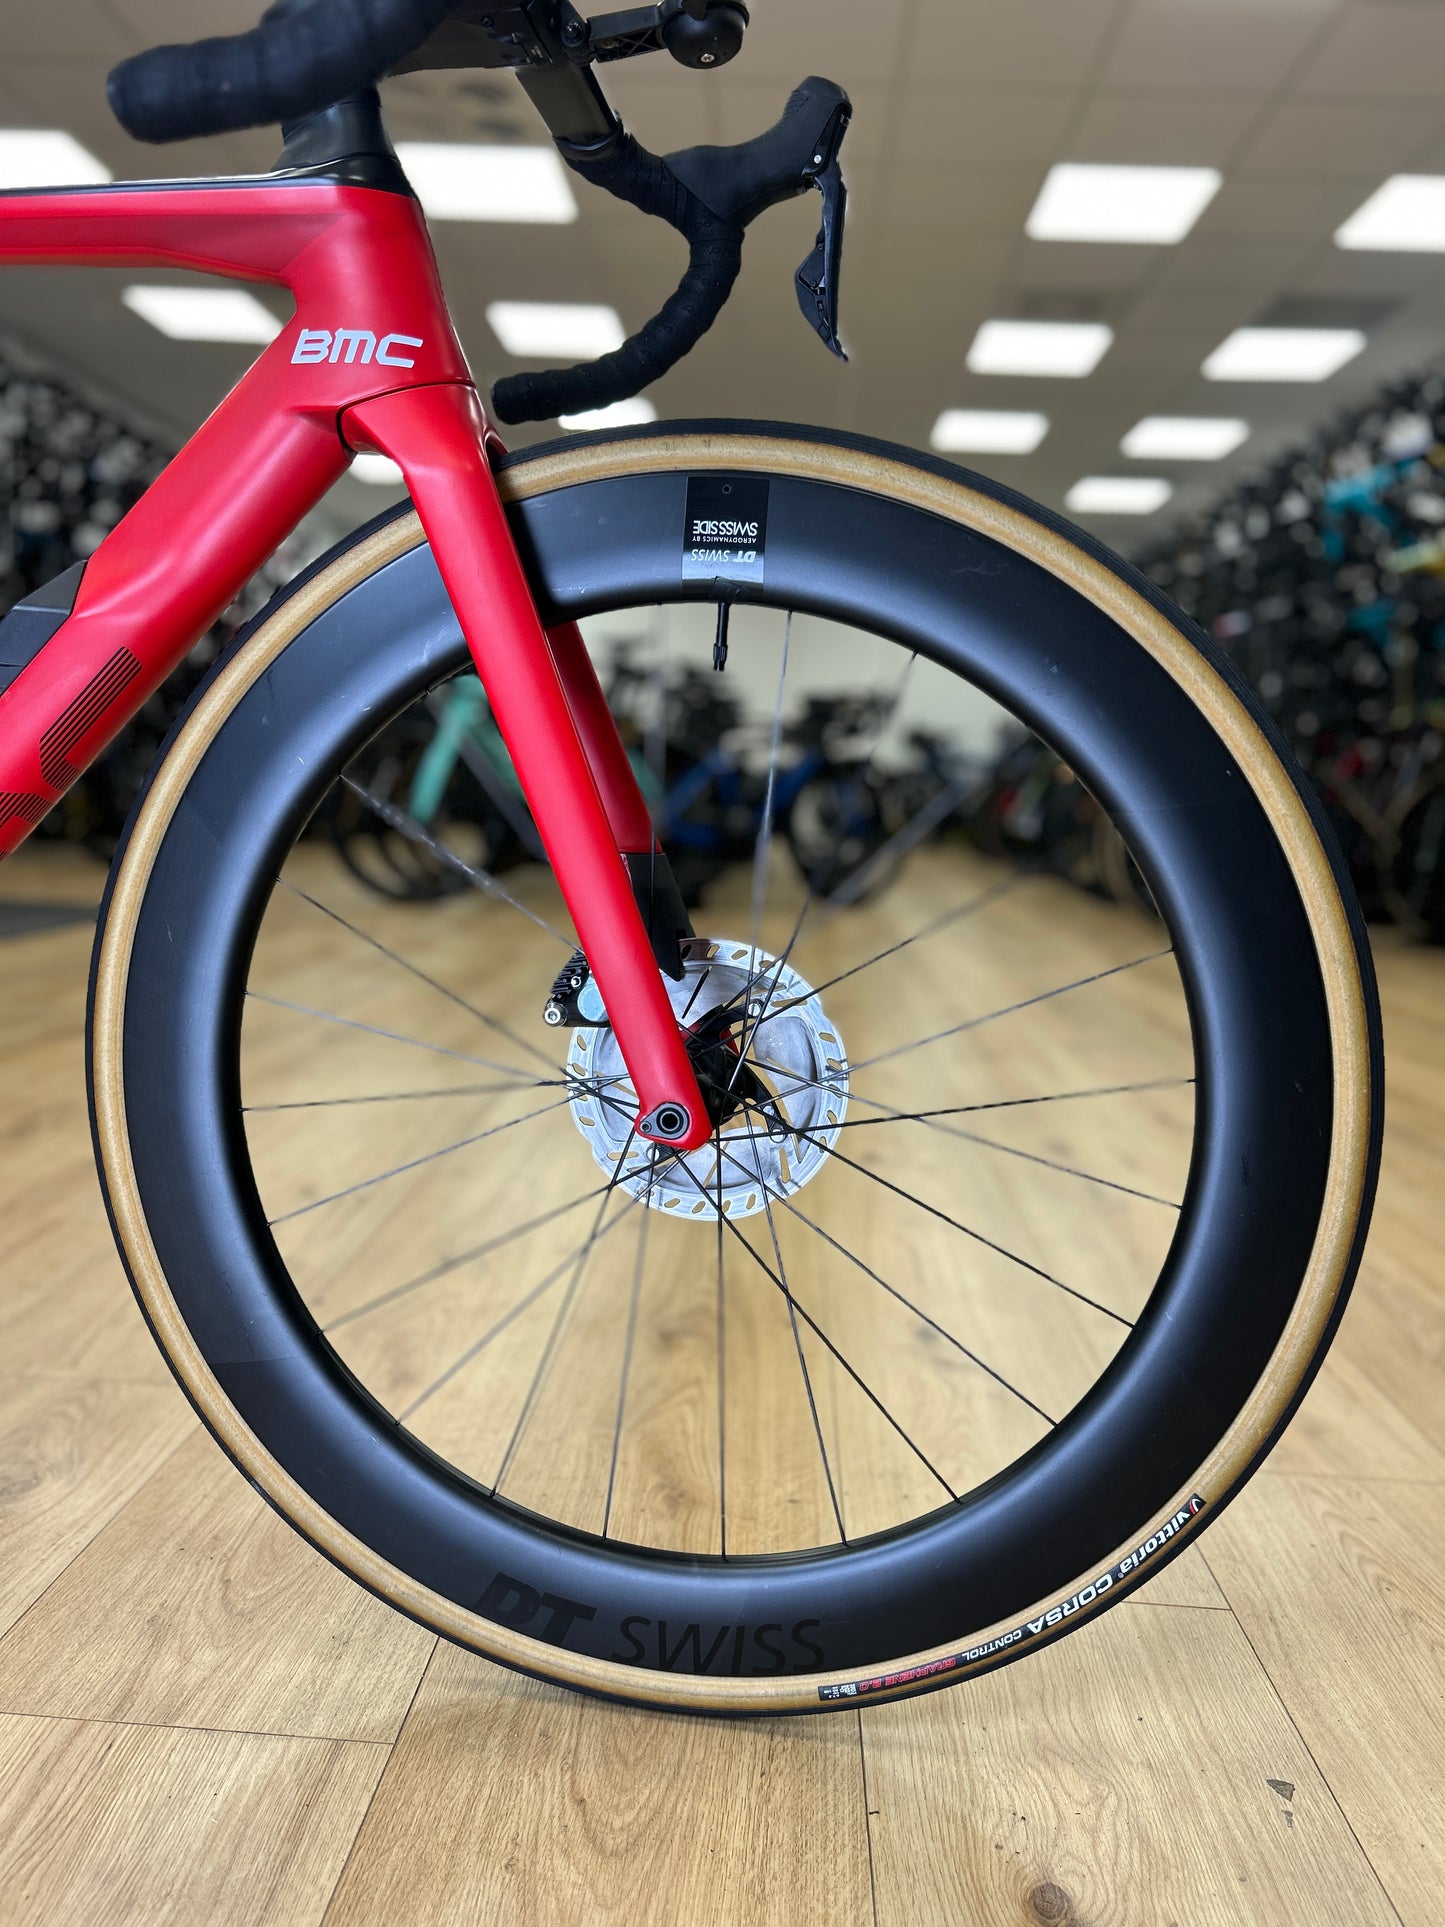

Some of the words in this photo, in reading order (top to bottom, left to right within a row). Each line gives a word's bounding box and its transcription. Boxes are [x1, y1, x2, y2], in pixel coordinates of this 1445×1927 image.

[290, 328, 423, 368] BMC
[703, 535, 757, 544] AERODYNAMICS
[690, 548, 730, 562] SWISS
[733, 550, 756, 563] DT
[1027, 1573, 1113, 1634] CORSA
[472, 1571, 597, 1646] DT
[611, 1615, 826, 1675] SWISS
[961, 1629, 1022, 1661] CONTROL
[858, 1679, 882, 1692] 2.0
[885, 1657, 957, 1686] GRAPHENE
